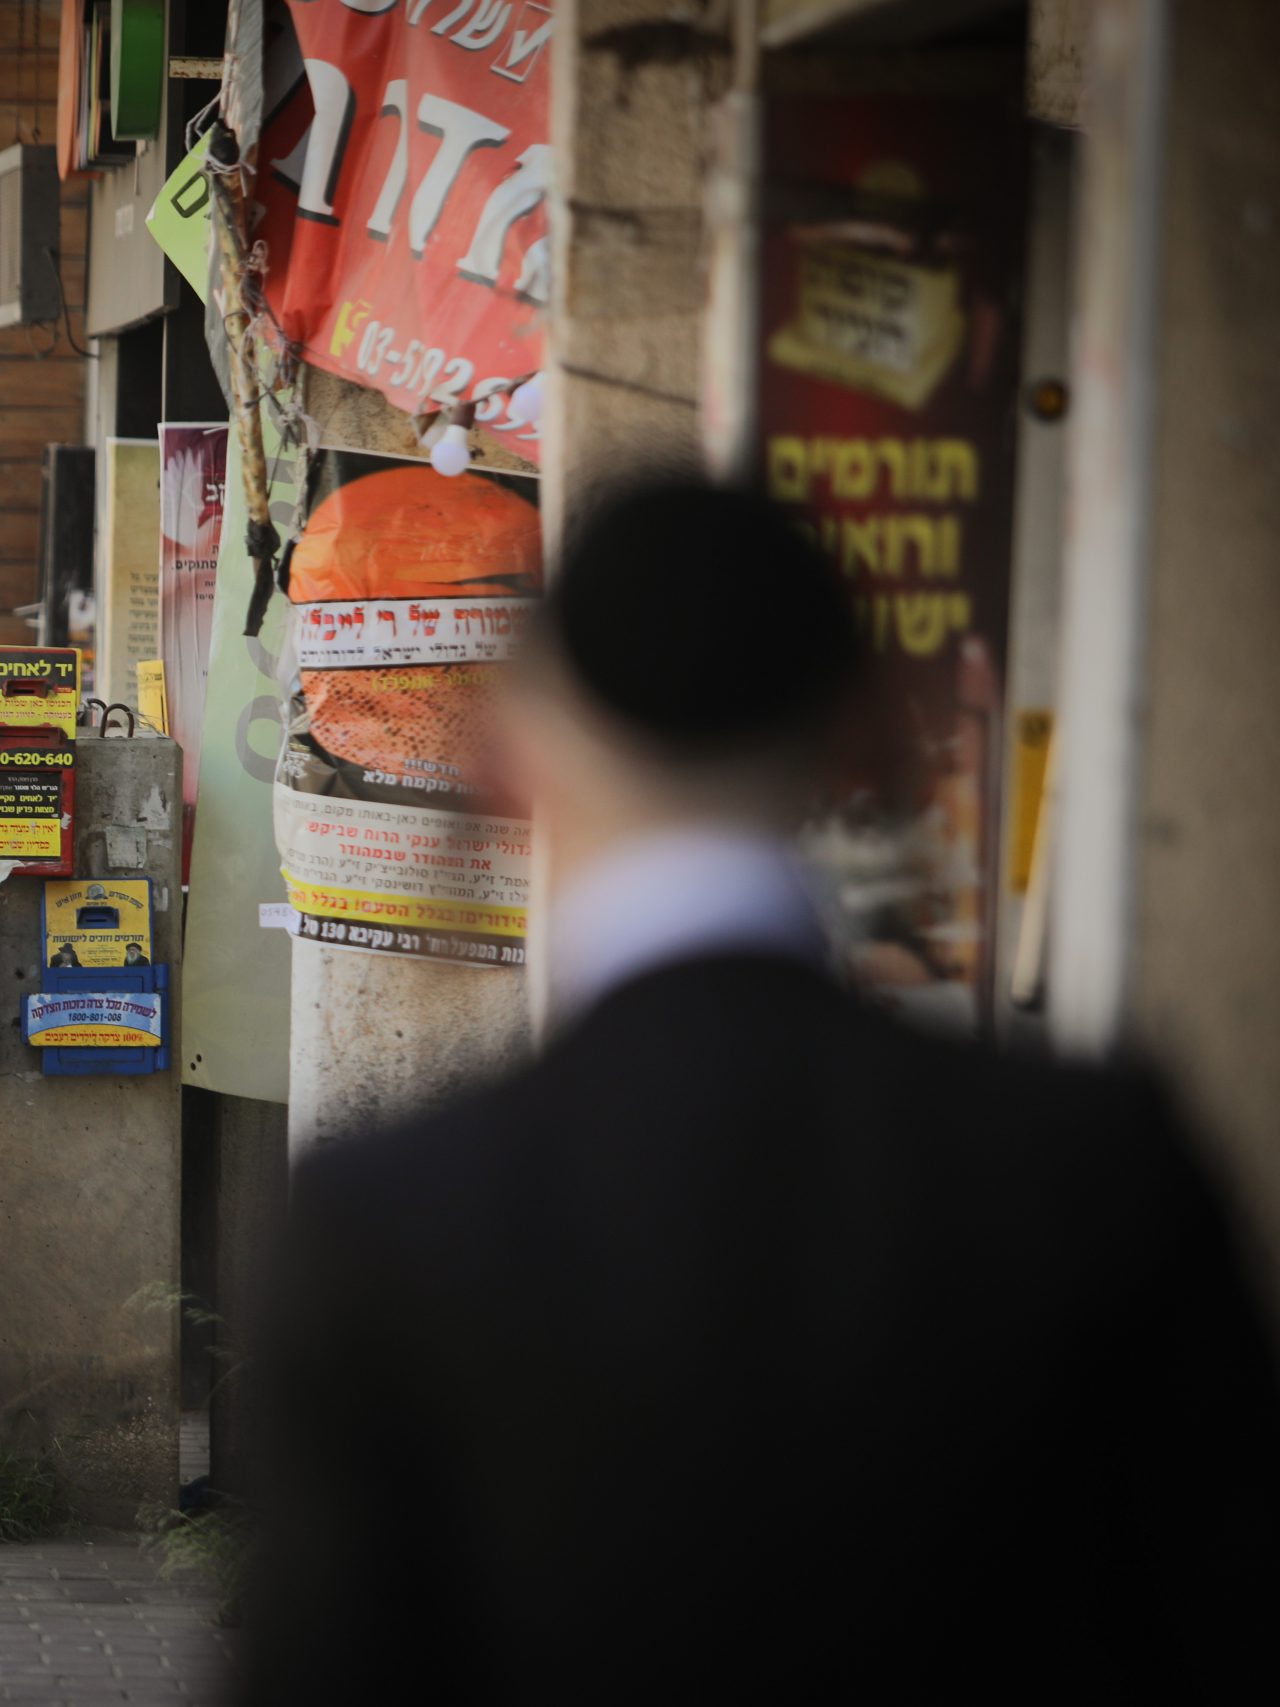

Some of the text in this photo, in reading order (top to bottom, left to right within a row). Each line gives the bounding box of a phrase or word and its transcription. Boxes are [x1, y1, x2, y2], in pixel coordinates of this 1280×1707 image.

[408, 603, 440, 637] של
[55, 663, 73, 677] יד
[363, 770, 397, 786] מלא
[19, 793, 43, 802] לאחים
[16, 806, 33, 814] פדיון
[365, 830, 400, 844] הרוח
[485, 823, 509, 836] שנה
[407, 833, 440, 849] ענקי
[446, 836, 490, 853] ישראל
[338, 843, 406, 862] שבמהודר
[469, 858, 492, 871] את
[311, 892, 348, 910] בגלל
[355, 899, 409, 917] הטעם!
[416, 905, 454, 922] בגלל
[320, 920, 345, 936] 130
[349, 925, 395, 949] עקיבא
[398, 933, 420, 951] רבי
[31, 1002, 61, 1019] הצדקה
[106, 998, 122, 1009] מכל
[122, 1001, 157, 1019] לשמירה
[122, 1033, 144, 1042] 100%
